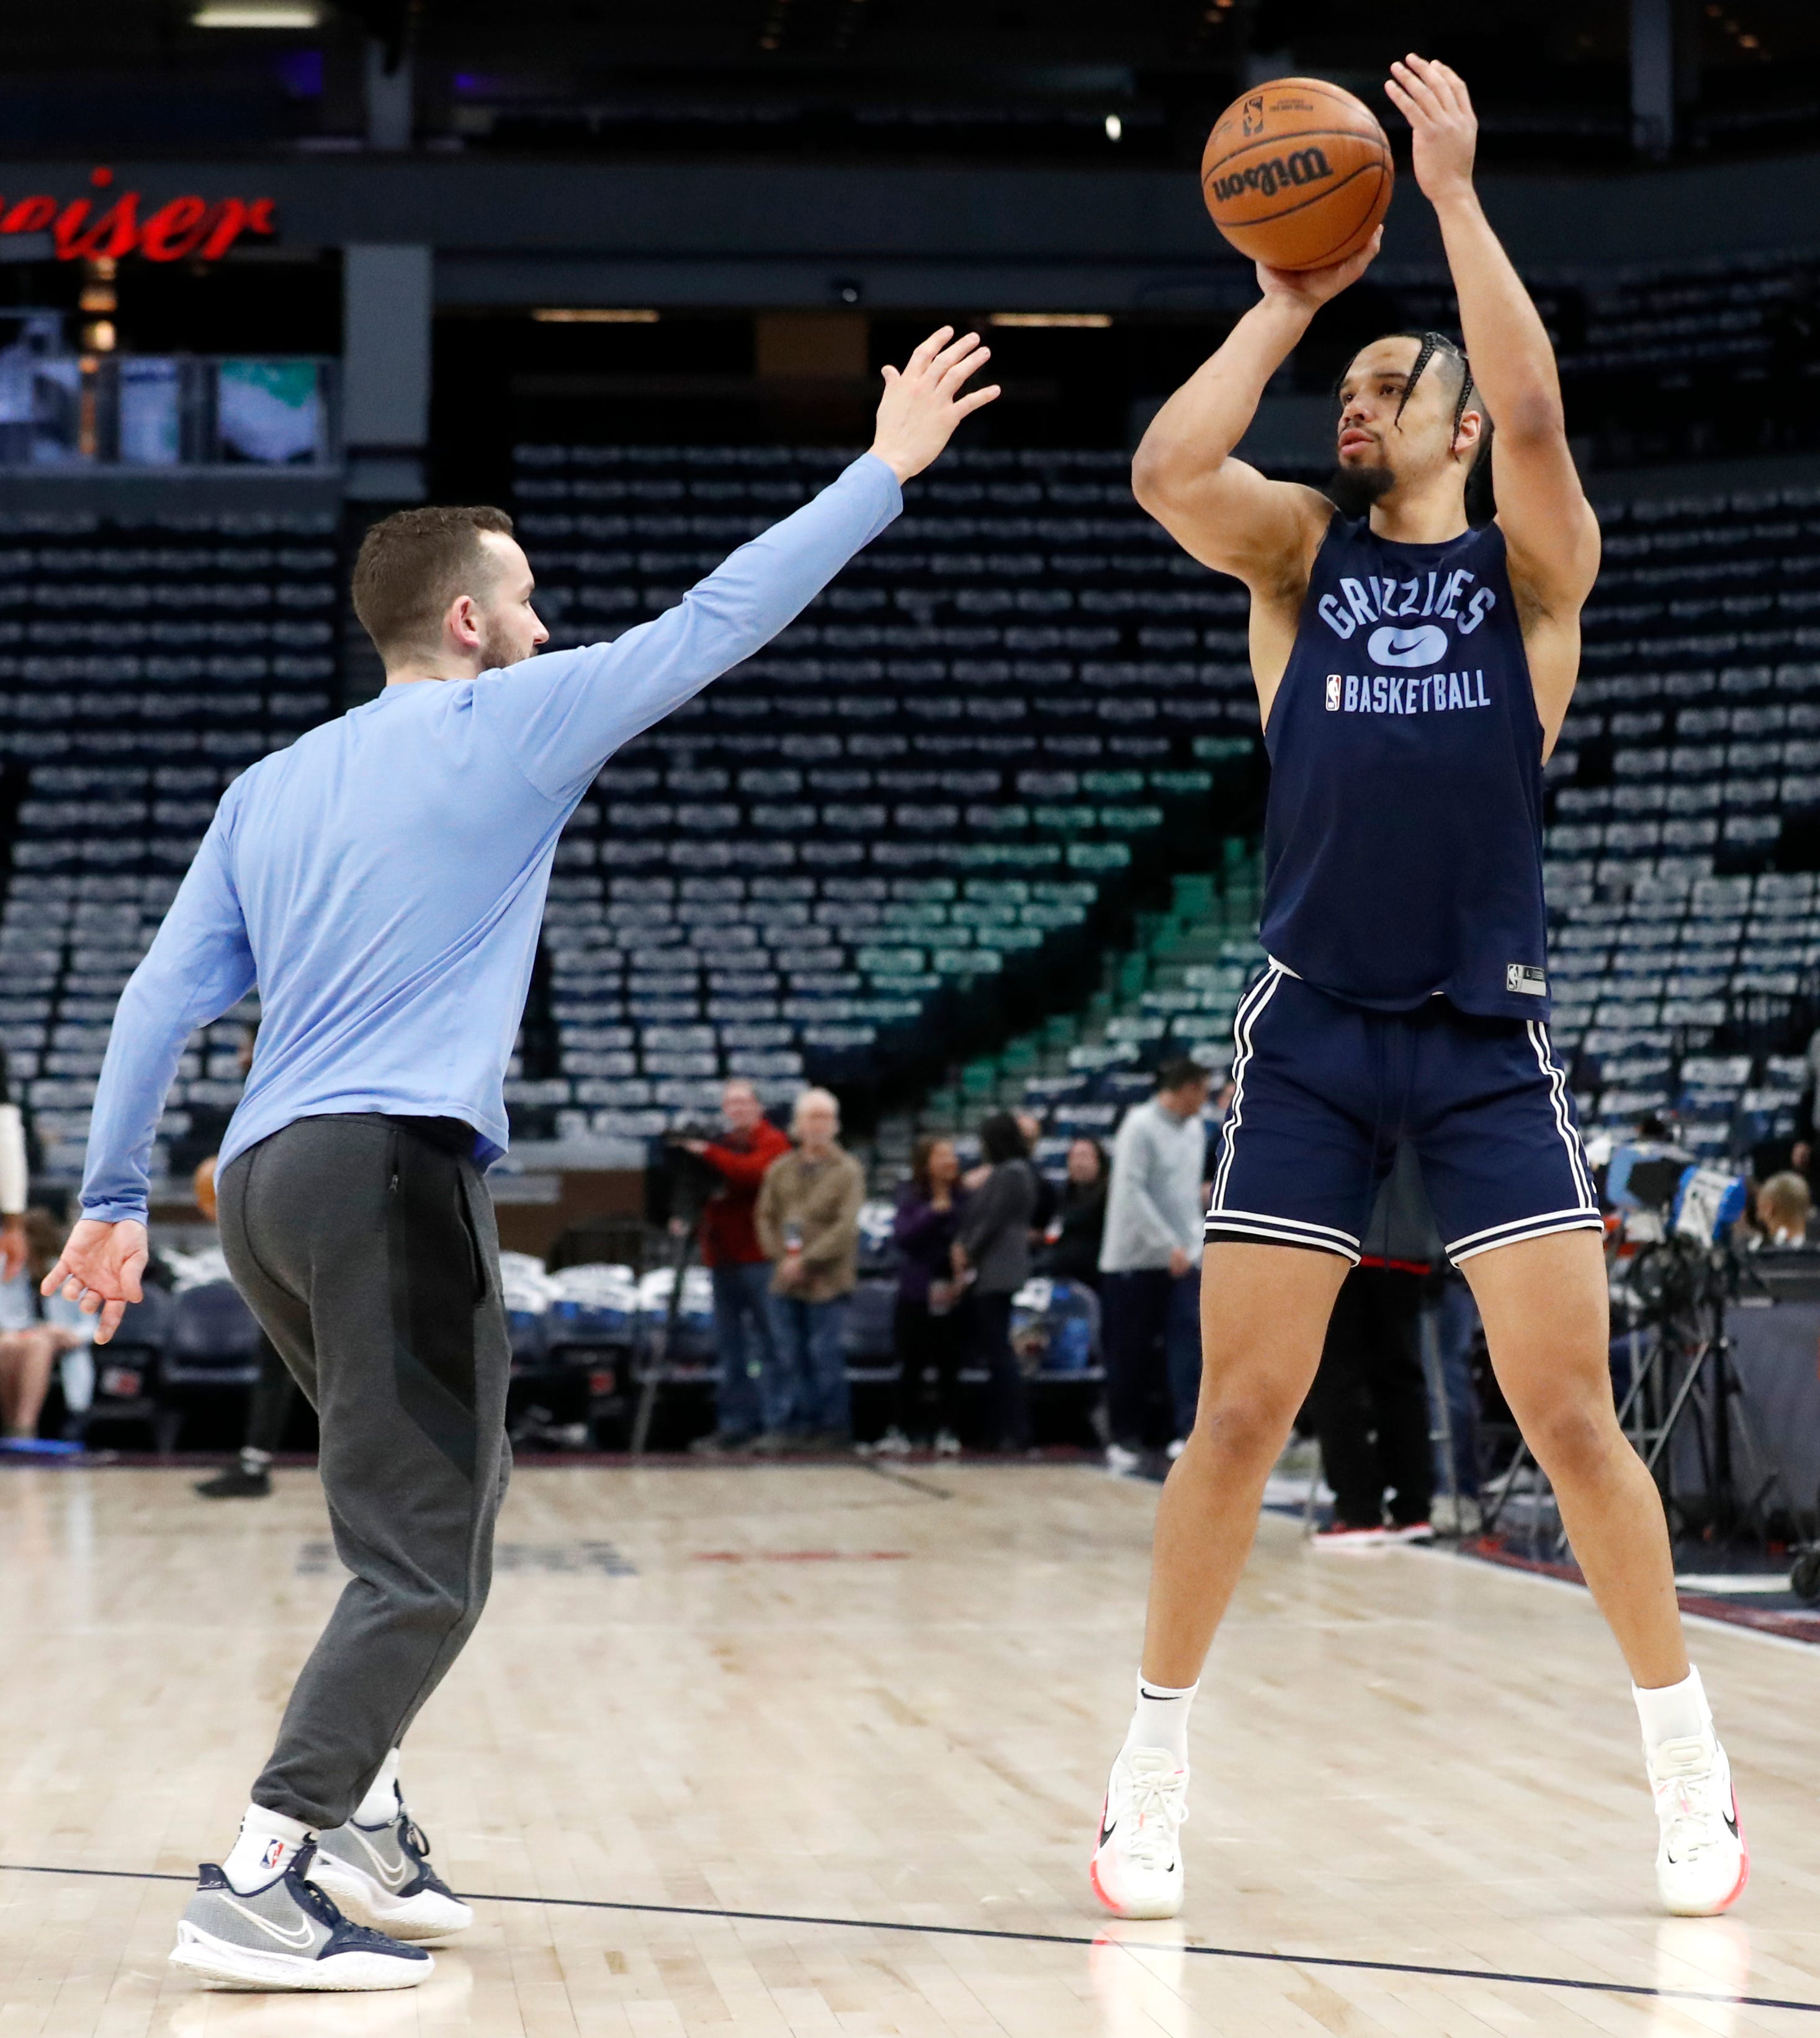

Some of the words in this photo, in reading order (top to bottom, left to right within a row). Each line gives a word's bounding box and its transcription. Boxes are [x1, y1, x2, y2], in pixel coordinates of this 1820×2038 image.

[1212, 147, 1334, 203] Wilson
[0, 166, 275, 261] eiser
[1317, 568, 1496, 640] GRIZZLIES
[1343, 669, 1491, 715] BASKETBALL
